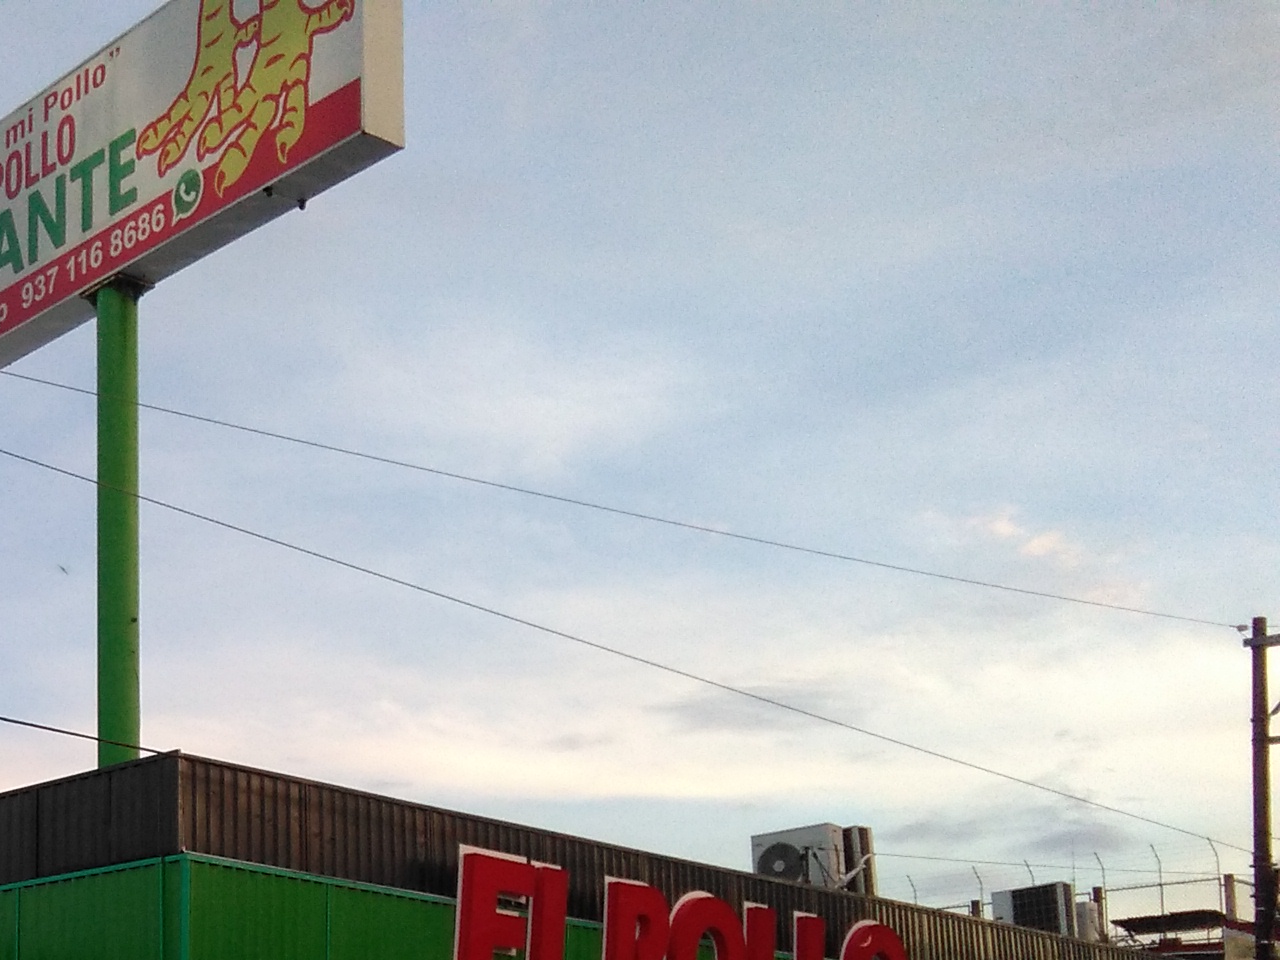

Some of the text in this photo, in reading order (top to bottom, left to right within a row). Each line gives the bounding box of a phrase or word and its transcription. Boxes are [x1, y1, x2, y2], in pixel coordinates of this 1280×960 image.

[5, 107, 34, 147] mi
[21, 263, 58, 309] 937
[65, 240, 103, 282] 116
[110, 203, 165, 259] 8686
